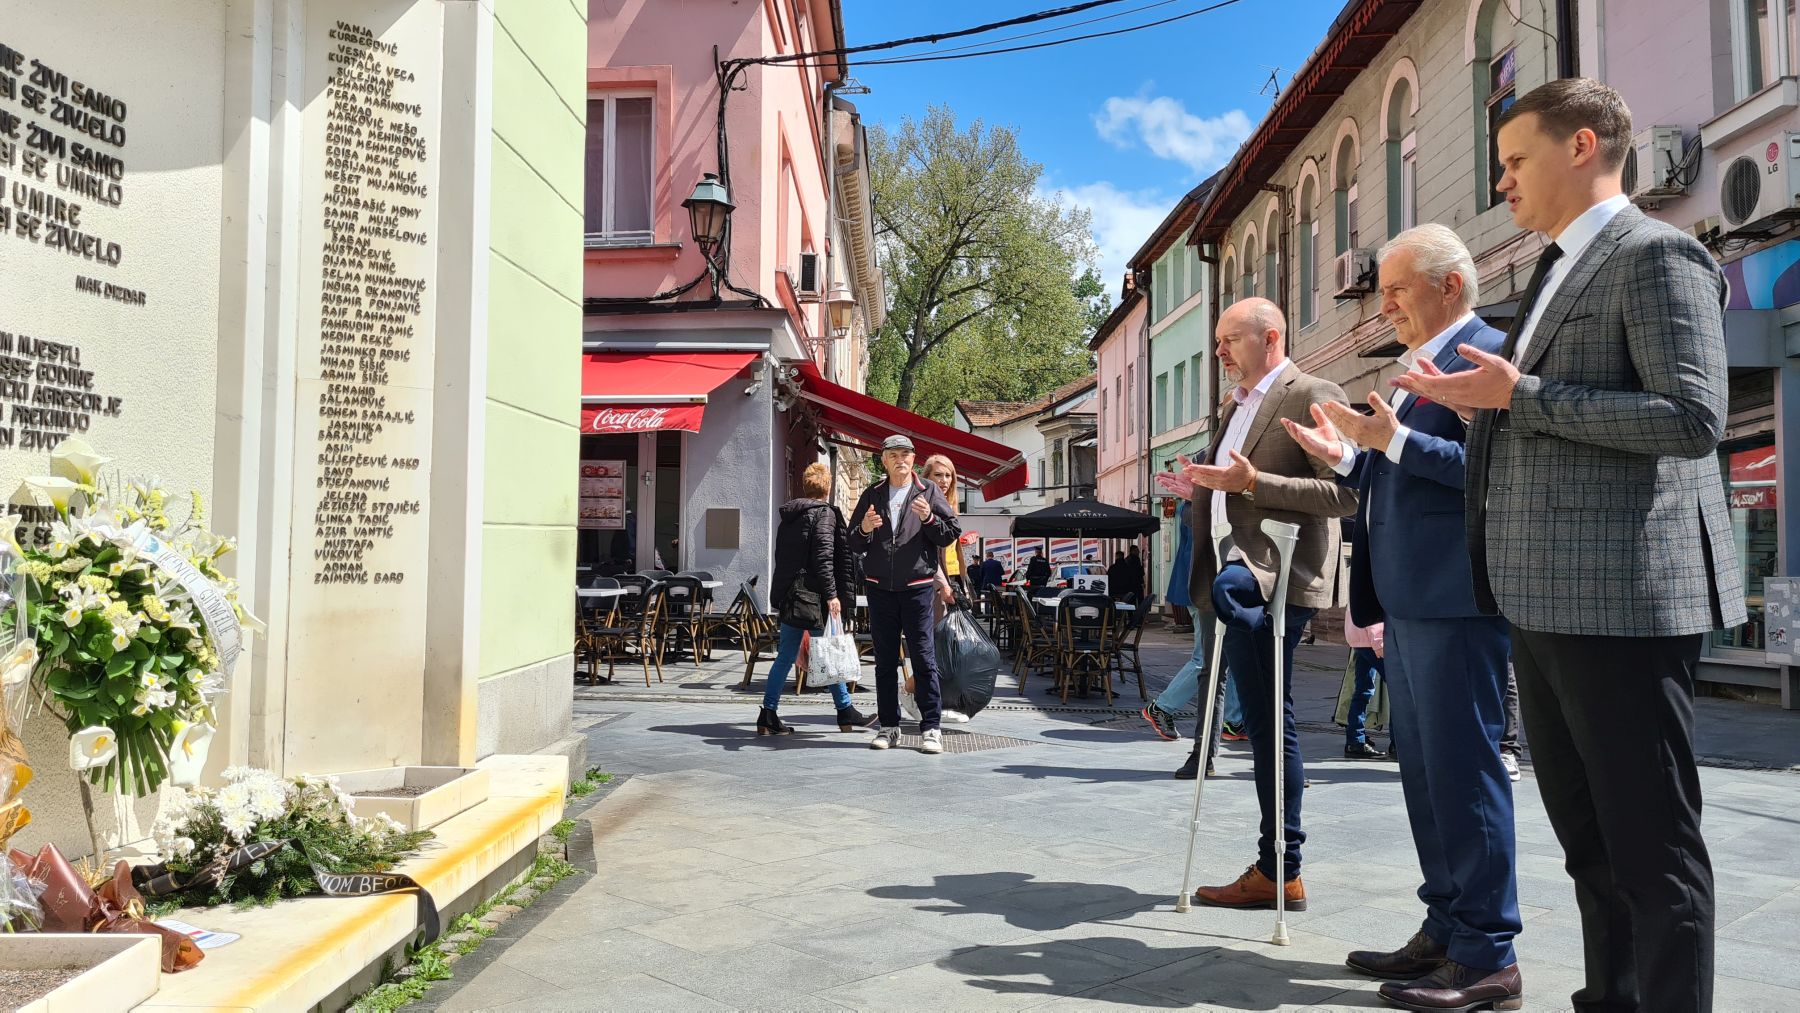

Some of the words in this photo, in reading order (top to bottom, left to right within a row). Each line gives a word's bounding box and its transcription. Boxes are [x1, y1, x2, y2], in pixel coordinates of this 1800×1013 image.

[337, 20, 373, 38] VANJA
[329, 29, 398, 56] KURBEGOVIĆ
[338, 44, 374, 62] VESNA
[328, 52, 382, 75] KURTALIĆ
[337, 67, 394, 89] SULEJMAN
[29, 59, 68, 98] ŽIVI
[71, 81, 127, 123] SAMO
[328, 76, 392, 99] MEHANOVIĆ
[327, 88, 357, 103] PERA
[364, 96, 422, 117] MARINOVIĆ
[335, 101, 372, 117] NENAD
[21, 84, 47, 114] SE
[50, 96, 126, 147] ŽIVJELO
[327, 109, 384, 130] MARKOVIĆ
[390, 122, 418, 138] NEŠO
[327, 122, 362, 138] AMIRA
[326, 133, 352, 147] EDIN
[26, 121, 66, 159] ŽIVI
[71, 142, 125, 181] SAMO
[365, 153, 400, 169] MEMIĆ
[1767, 163, 1779, 175] LG
[22, 149, 48, 180] SE
[57, 163, 122, 207] UMRLO
[326, 157, 382, 177] ADRIJANA
[389, 170, 417, 184] MILIĆ
[325, 169, 361, 185] NEŠET
[367, 178, 428, 199] MUJANOVIĆ
[333, 184, 359, 197] EDIN
[13, 181, 81, 229] UMIRE
[324, 206, 359, 222] SAMIR
[368, 214, 399, 229] MUJIĆ
[324, 218, 355, 234] ELVIR
[16, 211, 41, 242] SE
[45, 220, 122, 267] ŽIVJELO
[322, 255, 364, 270] DIJANA
[368, 260, 396, 275] NINIĆ
[322, 268, 361, 282] SELMA
[364, 273, 427, 292] NUHANOVIĆ
[322, 280, 360, 295] INDIRA
[76, 275, 102, 297] MAK
[104, 282, 147, 307] DIZDAR
[321, 293, 362, 308] RUSMIR
[369, 299, 421, 316] PONJAVIĆ
[322, 305, 348, 318] RAIF
[355, 309, 406, 325] RAHMANI
[321, 318, 374, 333] FAHRUDIN
[380, 324, 414, 338] RAMIĆ
[321, 331, 355, 343] NEDIM
[361, 333, 393, 347] REKIĆ
[18, 335, 80, 366] MJESTU
[320, 344, 377, 358] JASMINKO
[380, 348, 411, 363] ROSIĆ
[320, 356, 355, 370] NIHAD
[36, 362, 94, 391] GODINE
[320, 369, 356, 382] ARMIN
[327, 384, 376, 398] SENAHID
[32, 384, 102, 413] AGRESOR
[103, 396, 122, 417] JE
[319, 393, 386, 409] SALAMOVIĆ
[11, 404, 90, 433] PREKINUO
[361, 410, 415, 424] SARAJLIĆ
[593, 407, 671, 430] Coca-Cola
[328, 420, 383, 433] JASMINKA
[318, 430, 373, 444] SARAJLIĆ
[325, 443, 353, 455] ASIM
[324, 467, 354, 478] SAVO
[317, 476, 390, 491] STJEPANOVIĆ
[323, 491, 368, 503] JELENA
[315, 513, 352, 526] ILINKA
[315, 526, 347, 538] AZUR
[354, 525, 394, 538] VANTIĆ
[323, 539, 374, 551] MUSTAFA
[314, 549, 363, 561] VUKOVIĆ
[323, 562, 363, 573] ADNAN
[314, 571, 368, 584] ZAIMOVIĆ
